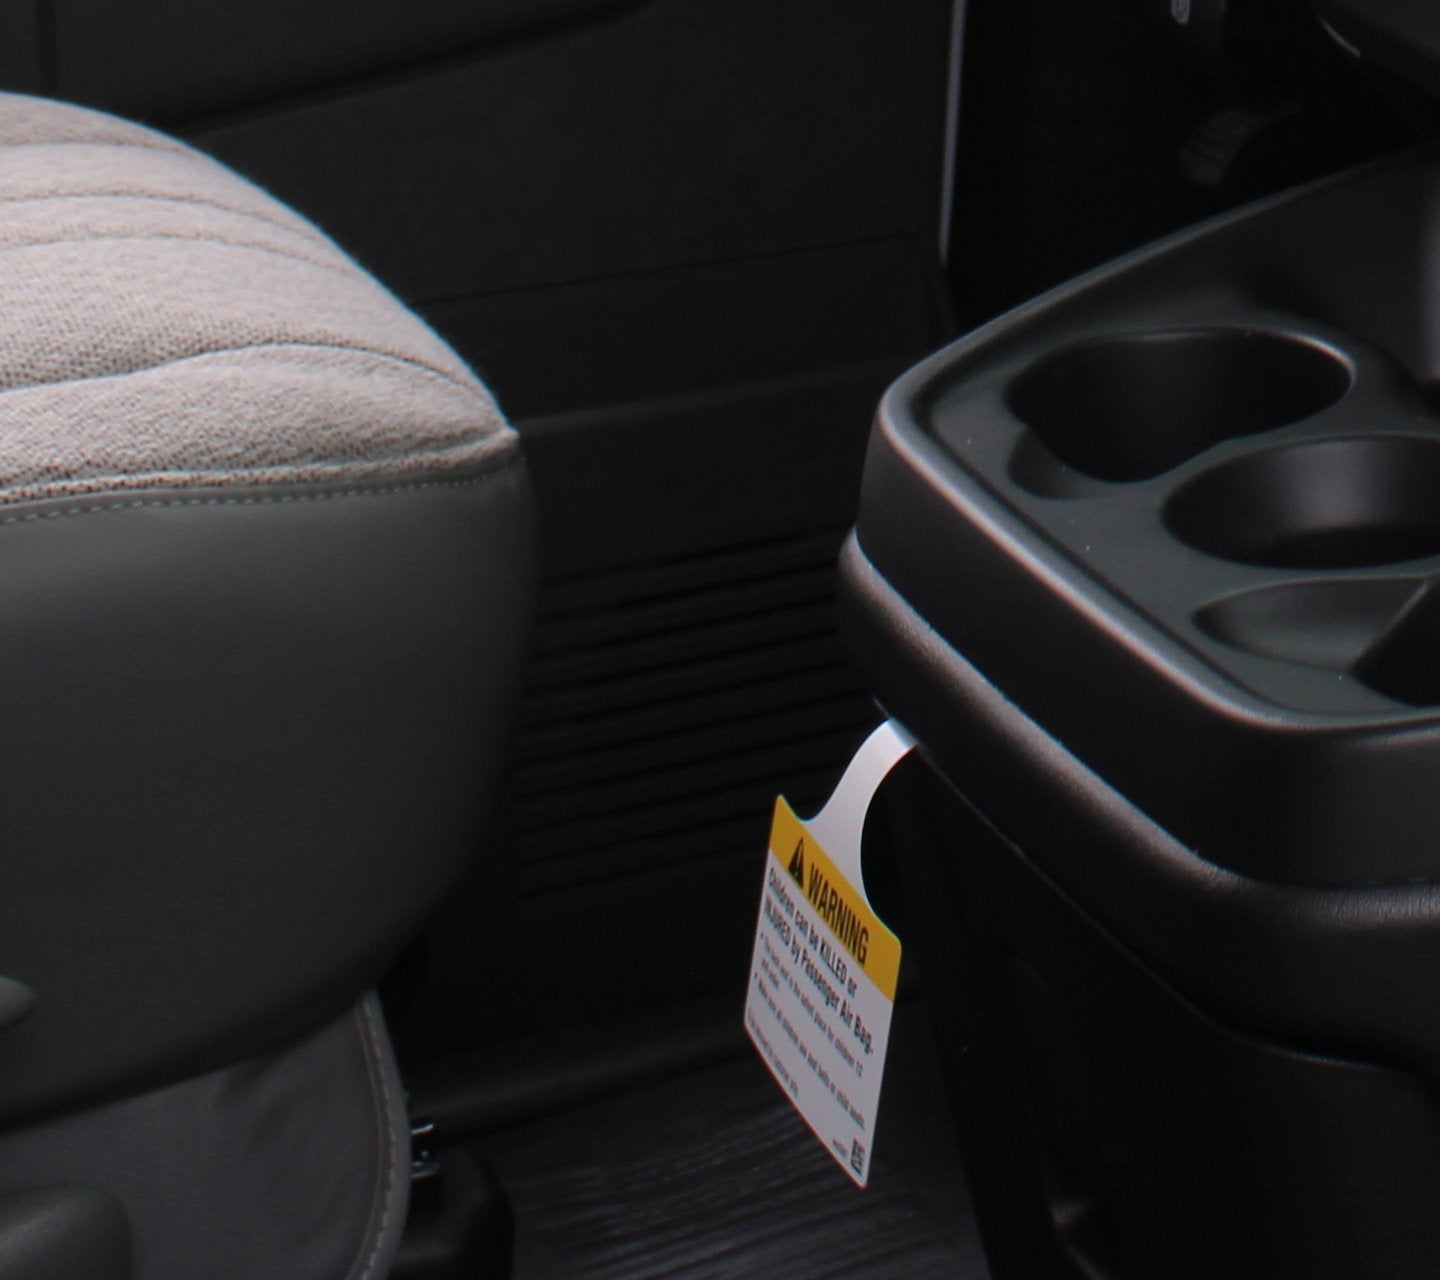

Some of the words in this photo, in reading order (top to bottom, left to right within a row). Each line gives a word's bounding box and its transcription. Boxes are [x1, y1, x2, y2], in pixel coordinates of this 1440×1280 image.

[769, 867, 795, 918] Children
[820, 937, 847, 985] KILLED
[847, 976, 857, 998] or
[808, 862, 869, 967] WARNING
[791, 934, 801, 964] by
[801, 948, 840, 1011] Passenger
[840, 998, 853, 1028] Air
[854, 1015, 873, 1055] Bag.
